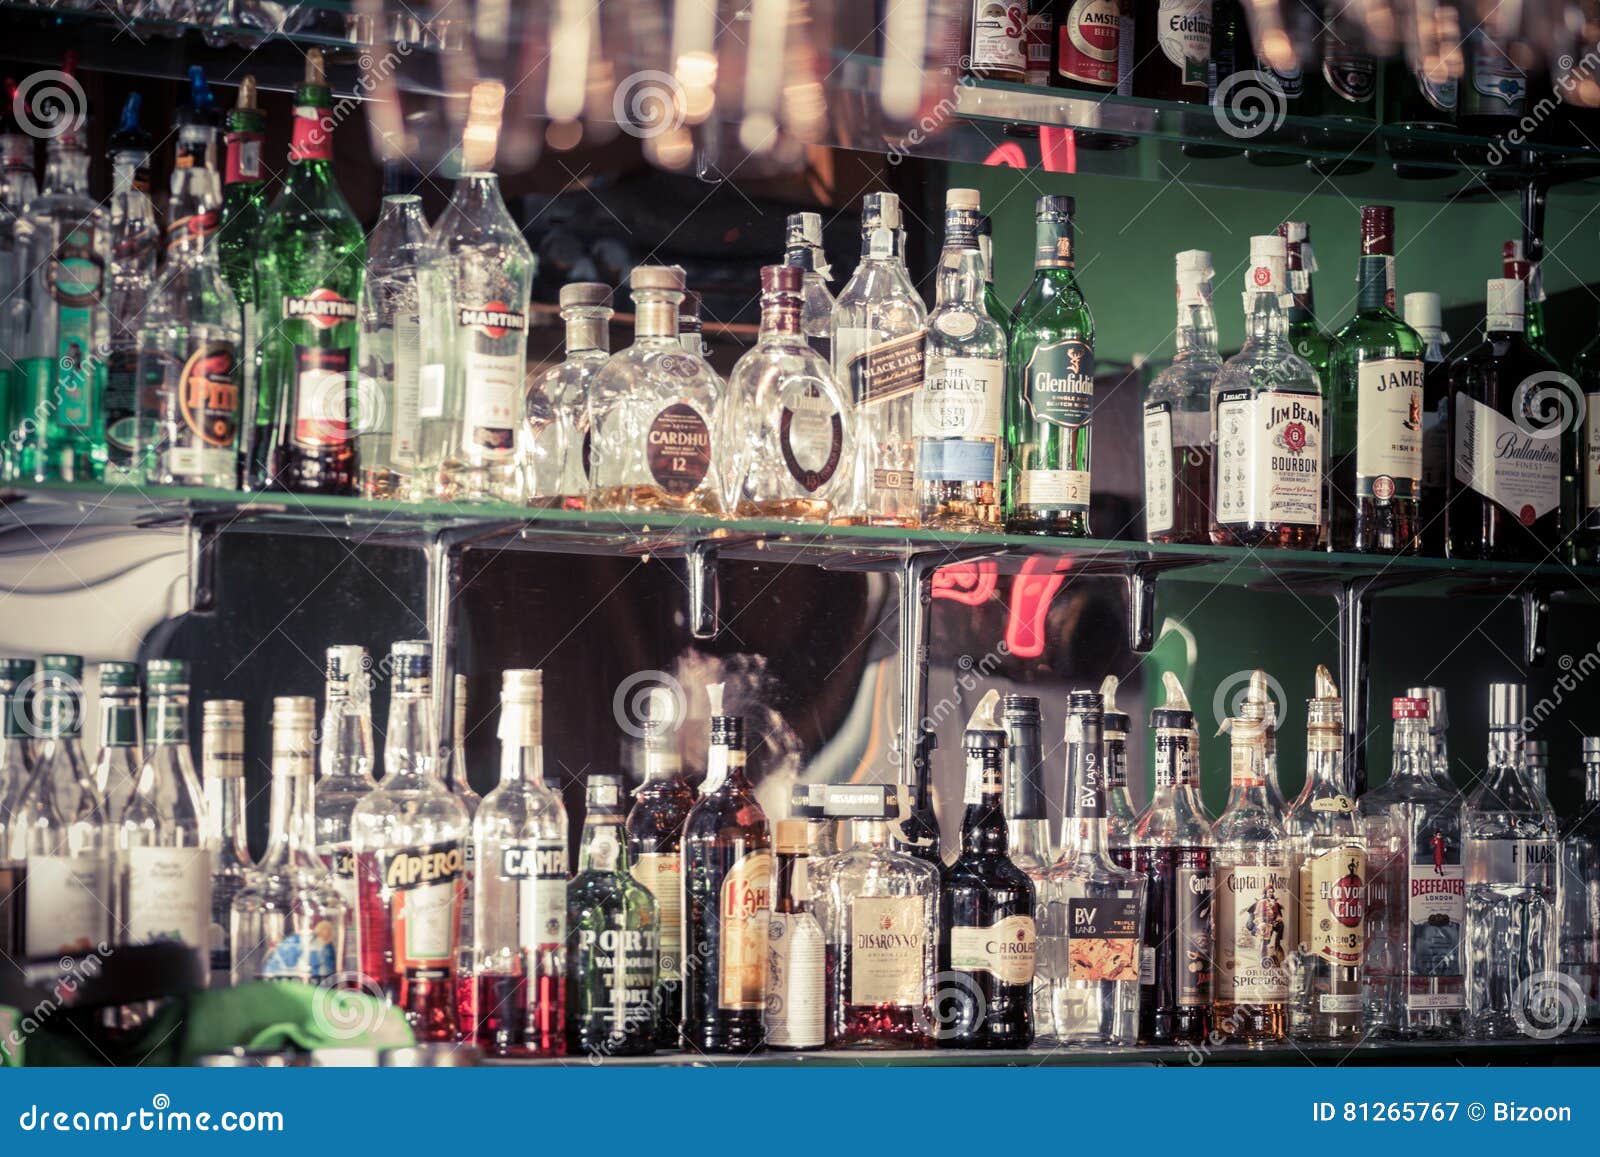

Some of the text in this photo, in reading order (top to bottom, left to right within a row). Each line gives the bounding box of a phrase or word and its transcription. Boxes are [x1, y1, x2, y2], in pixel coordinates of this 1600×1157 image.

[290, 299, 356, 315] MARTINI
[462, 310, 524, 330] MARTINI
[863, 361, 896, 378] BLACK
[943, 368, 964, 378] THE
[1266, 406, 1290, 430] JIM
[649, 431, 708, 446] CARDHU
[672, 457, 687, 471] 12
[1271, 456, 1317, 473] BOURBON
[1065, 486, 1078, 498] 12
[1081, 785, 1096, 808] BV
[1227, 873, 1266, 893] Captain
[1411, 878, 1465, 897] BEEFEATER
[1075, 907, 1097, 925] BV
[1334, 901, 1363, 918] Club
[1075, 926, 1096, 934] LAND
[857, 934, 919, 950] DISARONNO
